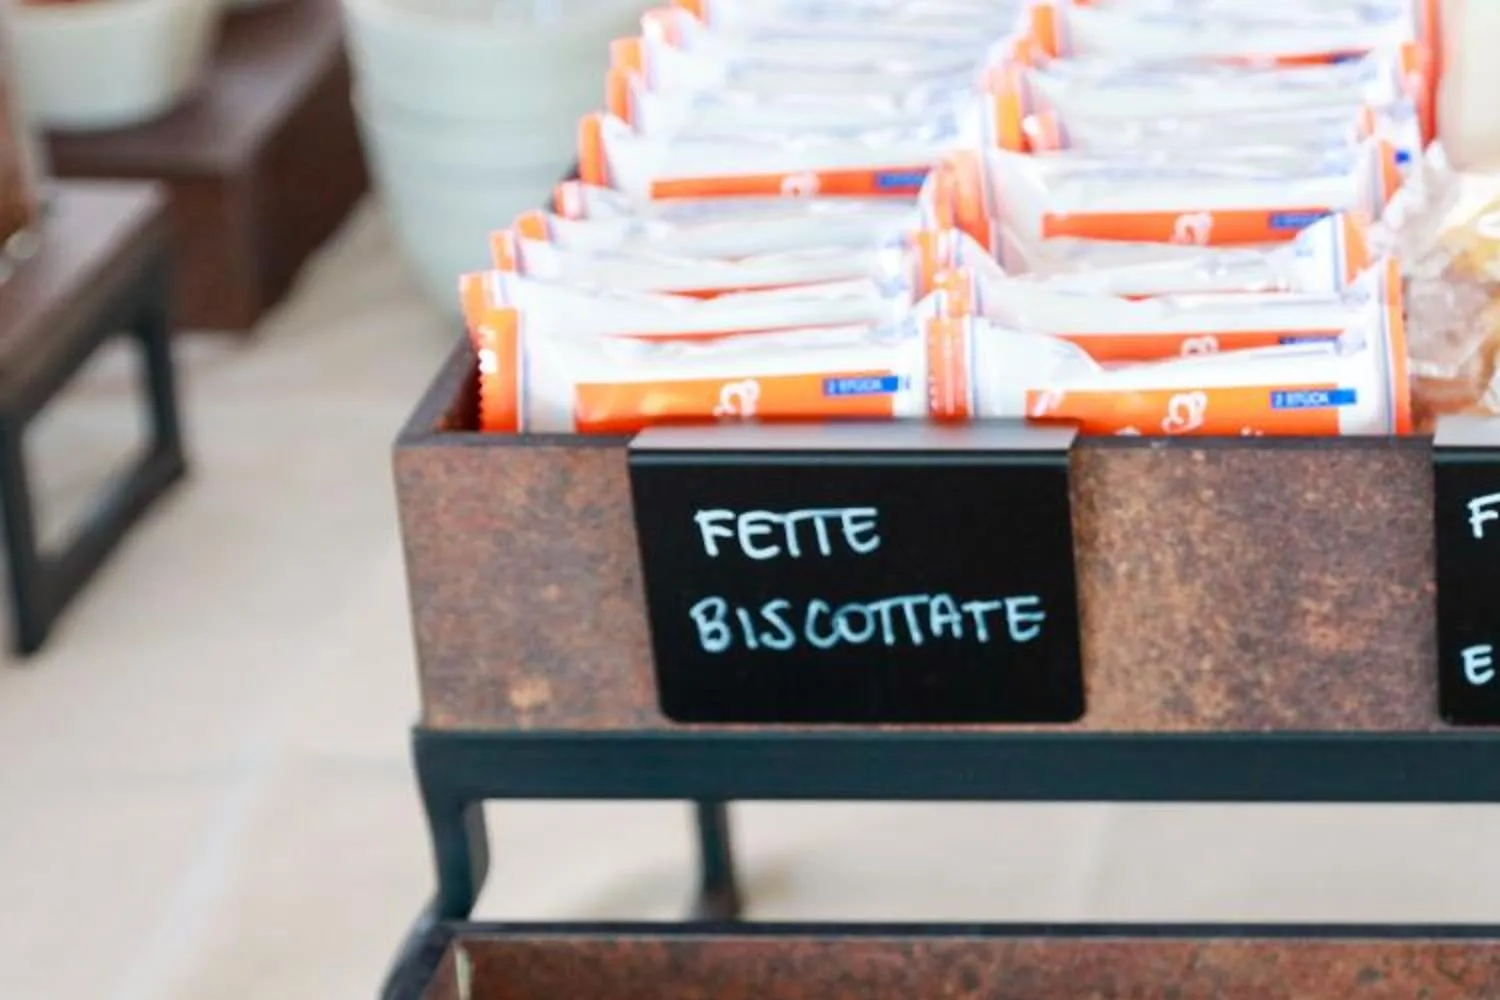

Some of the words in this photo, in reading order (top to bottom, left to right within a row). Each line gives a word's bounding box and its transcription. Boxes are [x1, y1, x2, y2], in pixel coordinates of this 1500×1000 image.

[694, 507, 880, 559] FETTE
[690, 594, 1046, 652] BISCOTTATE
[1461, 645, 1495, 684] E
